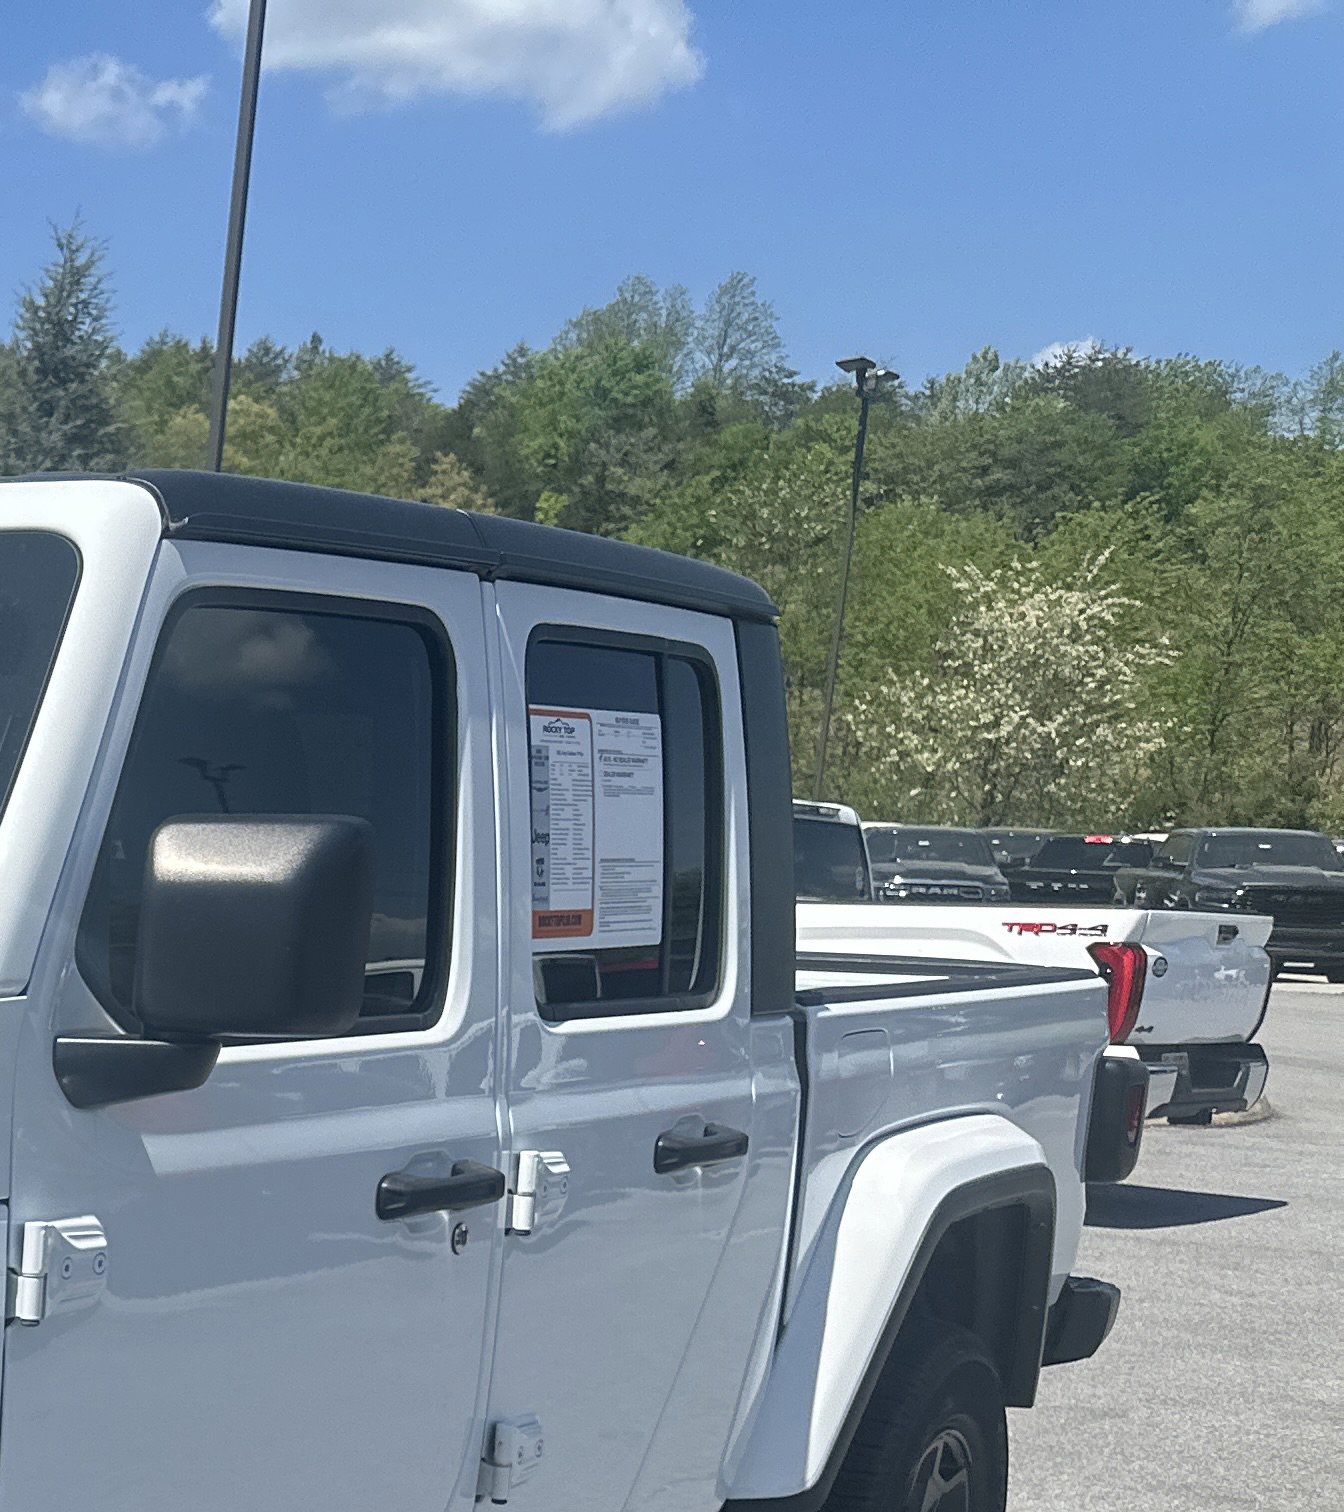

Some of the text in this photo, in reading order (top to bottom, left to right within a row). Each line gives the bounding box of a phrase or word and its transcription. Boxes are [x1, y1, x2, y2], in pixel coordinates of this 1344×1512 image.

[542, 725, 576, 735] ROCKY TOP
[532, 829, 550, 846] Jeep
[912, 887, 959, 895] RAM
